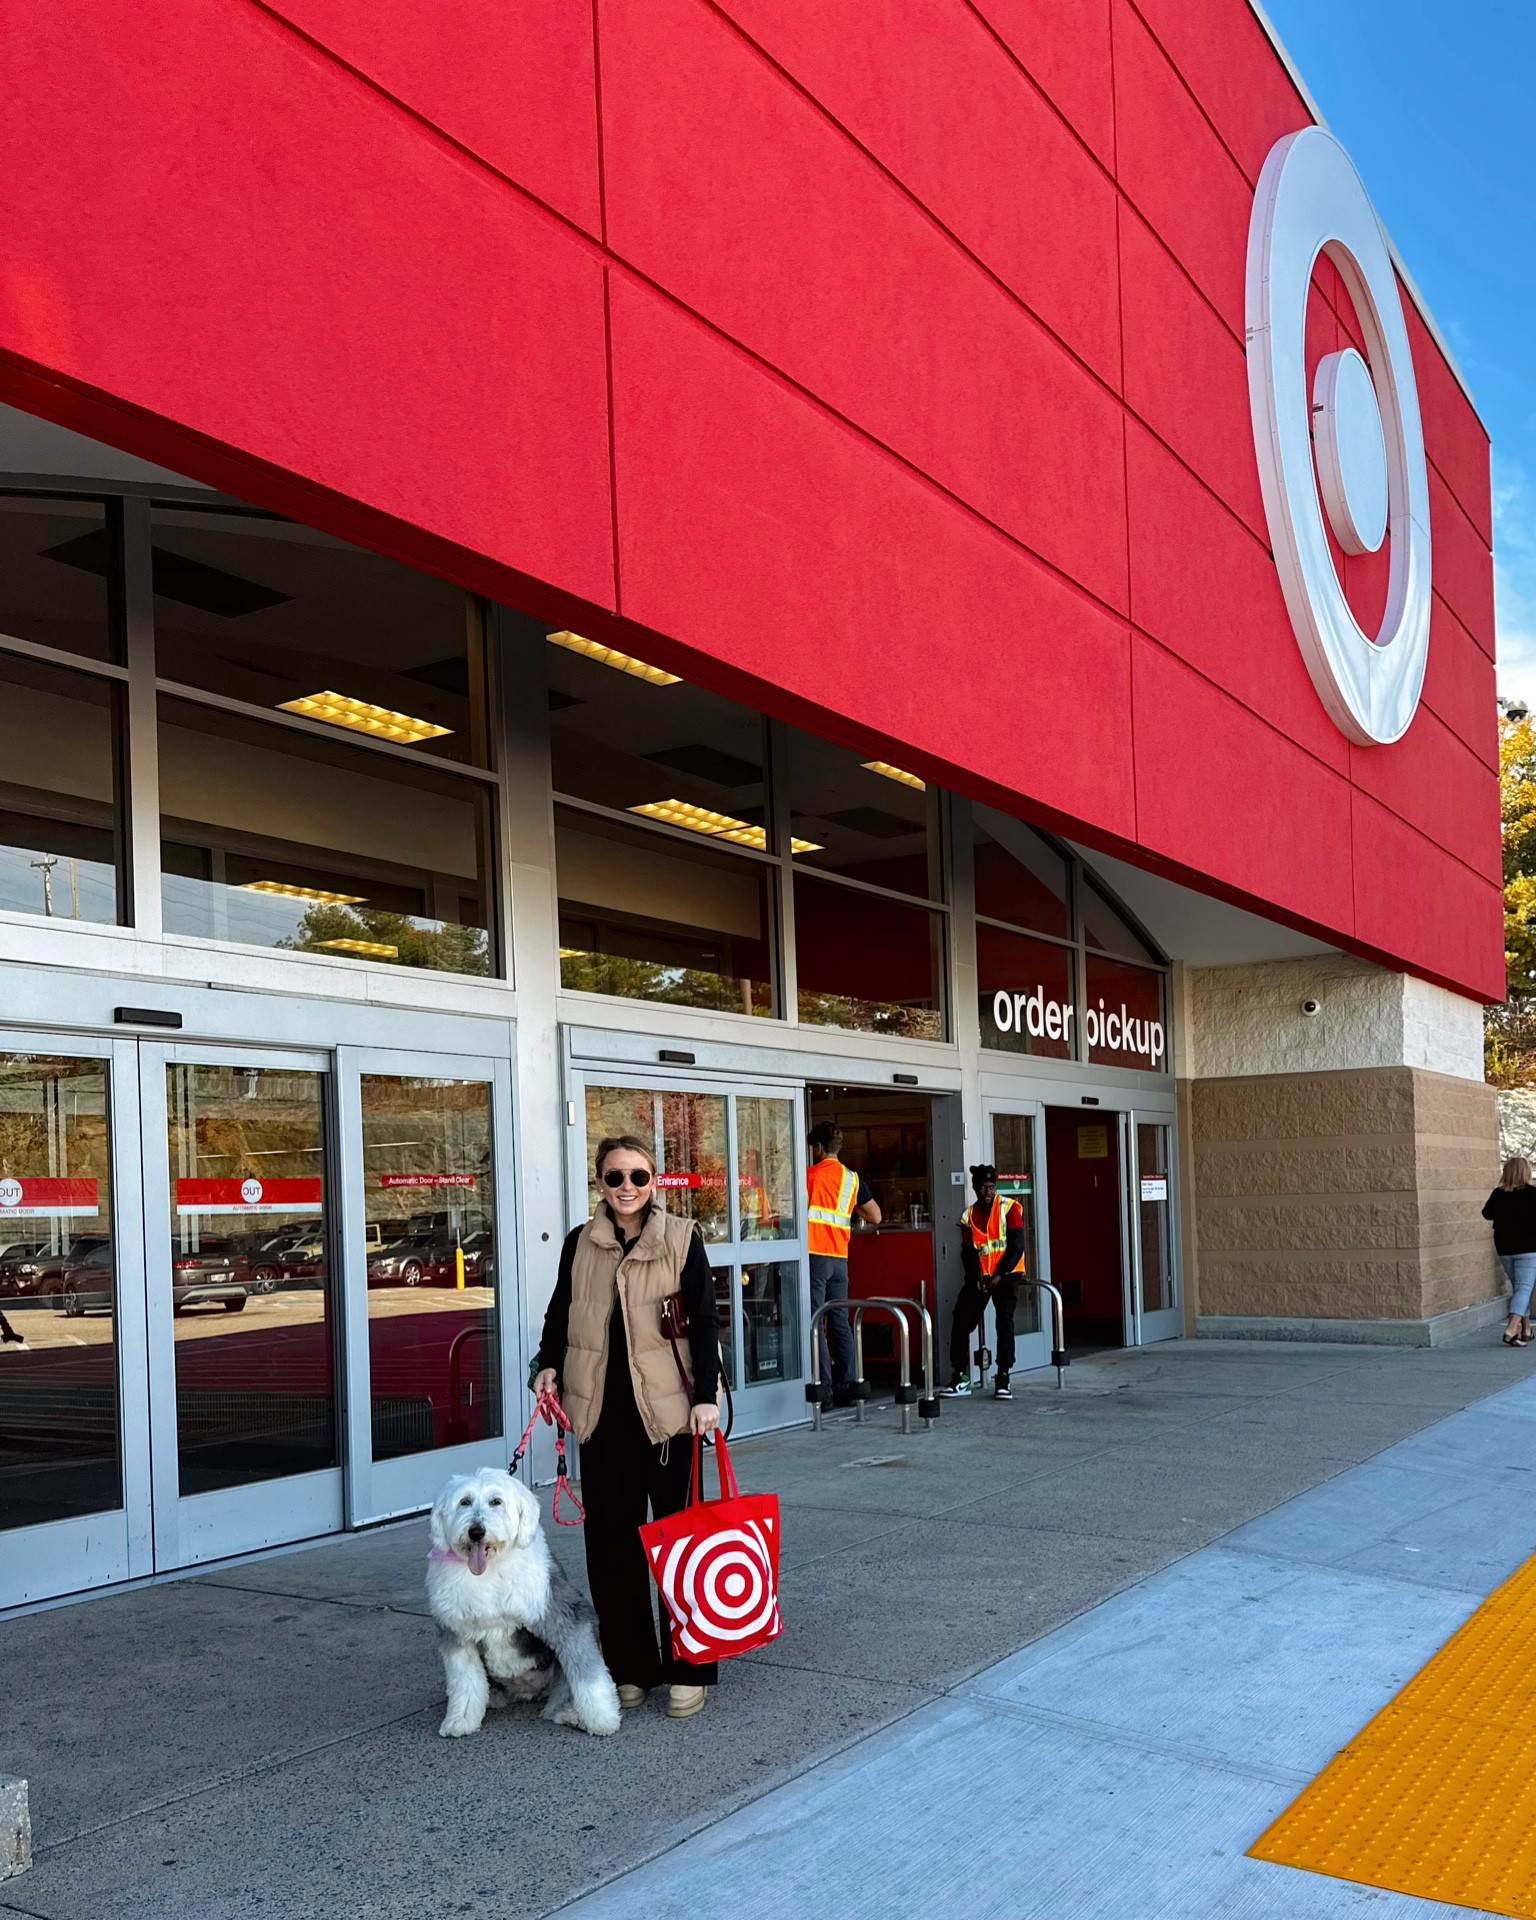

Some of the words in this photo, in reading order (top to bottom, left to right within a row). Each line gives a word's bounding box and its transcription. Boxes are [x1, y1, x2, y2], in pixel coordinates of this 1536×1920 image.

[993, 985, 1074, 1042] order
[657, 1176, 689, 1186] Entrance
[700, 1177, 713, 1186] Not
[243, 1187, 261, 1196] OUT
